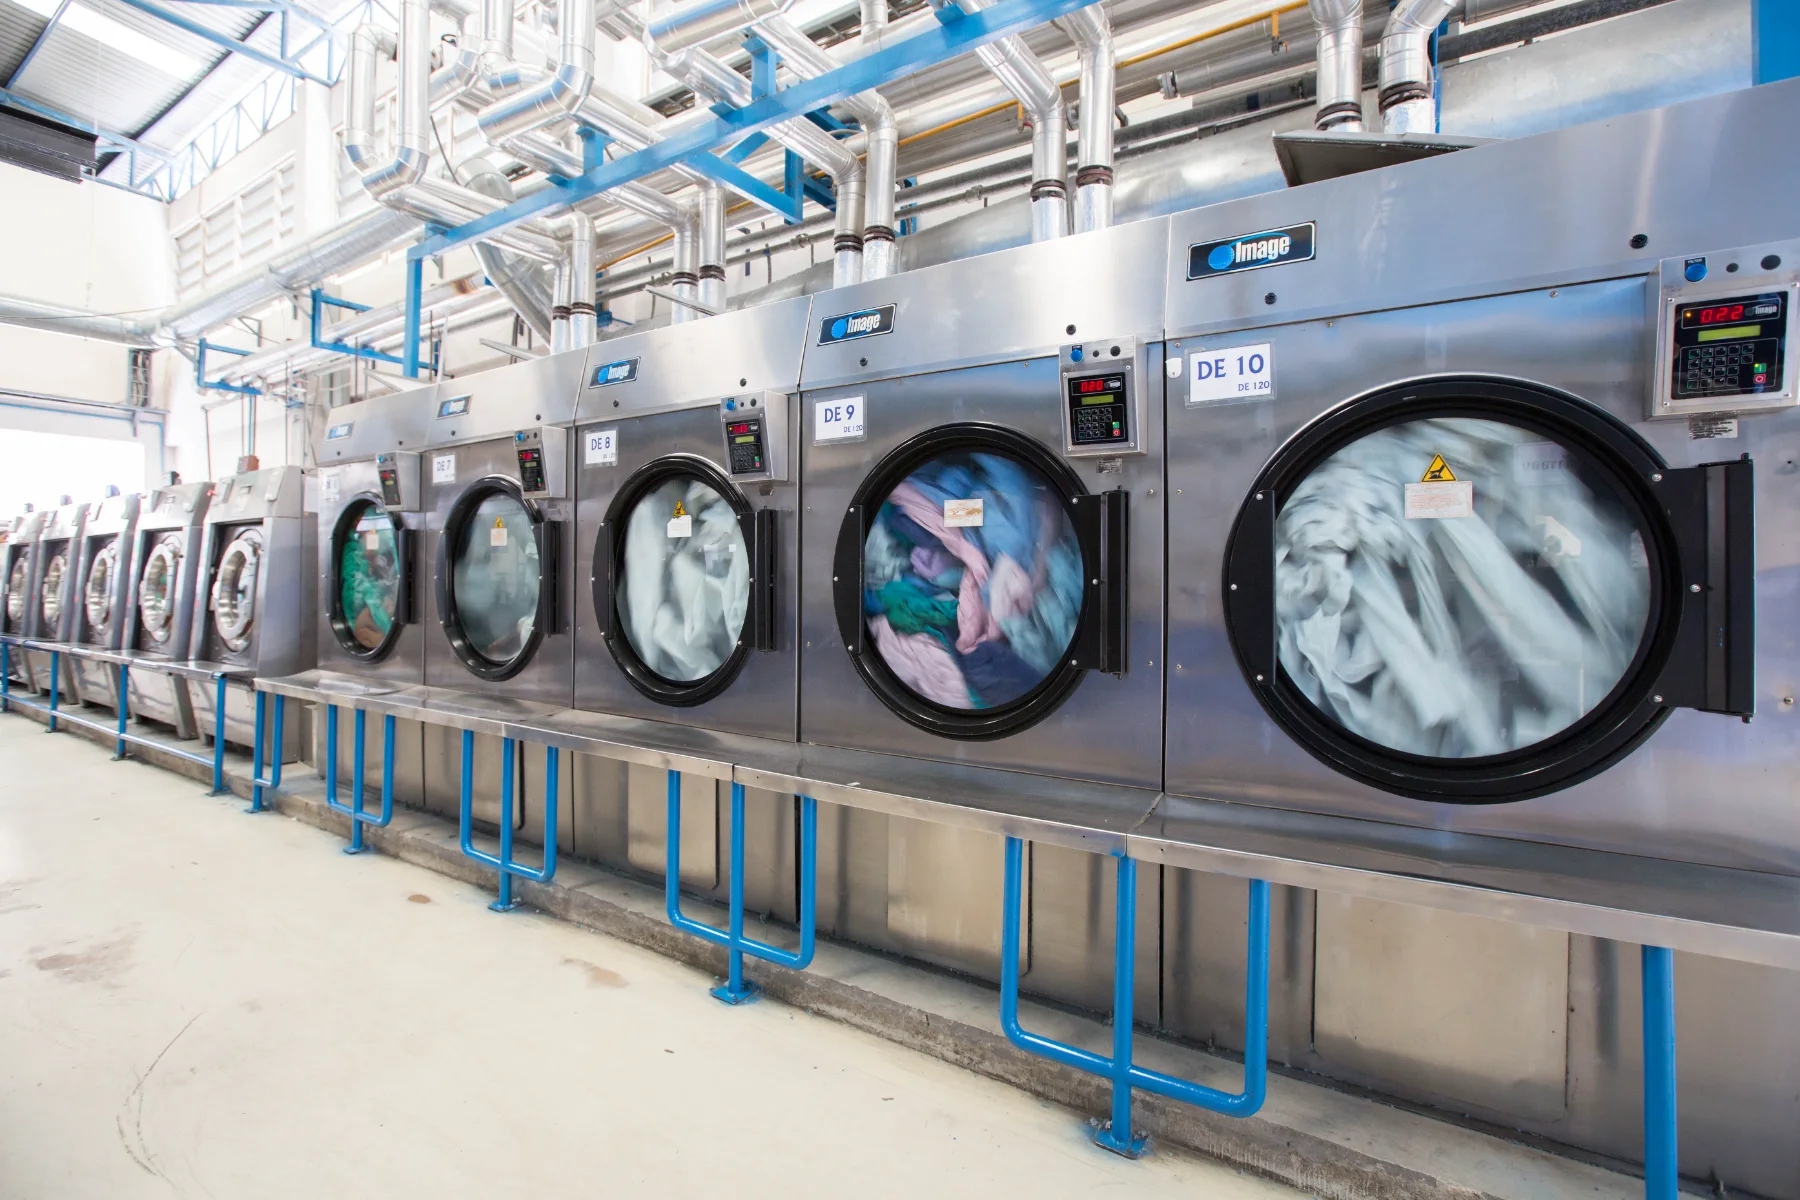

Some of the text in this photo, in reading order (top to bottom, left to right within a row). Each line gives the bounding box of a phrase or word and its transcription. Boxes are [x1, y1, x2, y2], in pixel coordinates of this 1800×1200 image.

[1235, 236, 1290, 263] Image
[1701, 305, 1744, 323] 022
[1755, 305, 1777, 315] Image
[847, 314, 880, 333] Image
[607, 364, 630, 380] Image
[1197, 354, 1264, 380] DE 10
[1238, 381, 1270, 391] DE 120
[824, 404, 855, 423] DE 9
[591, 436, 610, 451] DE 8
